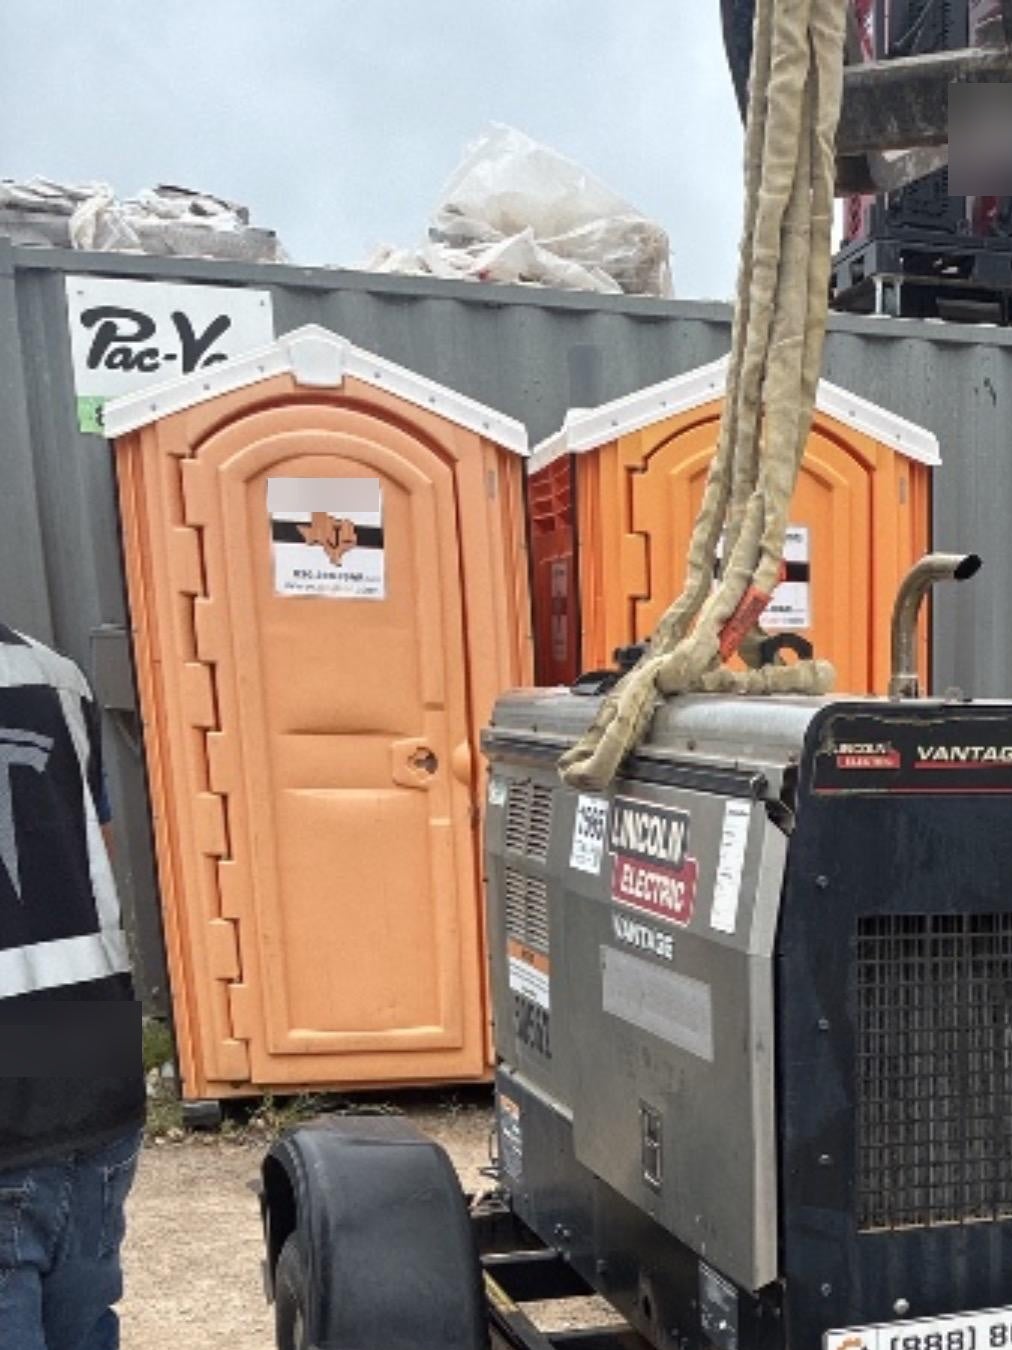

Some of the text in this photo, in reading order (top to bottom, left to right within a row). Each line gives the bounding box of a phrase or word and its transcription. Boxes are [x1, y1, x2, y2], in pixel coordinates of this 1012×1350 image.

[80, 306, 232, 374] Pac-V
[611, 809, 685, 864] LINCOLN
[620, 863, 685, 912] ELECTRIC
[612, 914, 674, 961] VANTAGE
